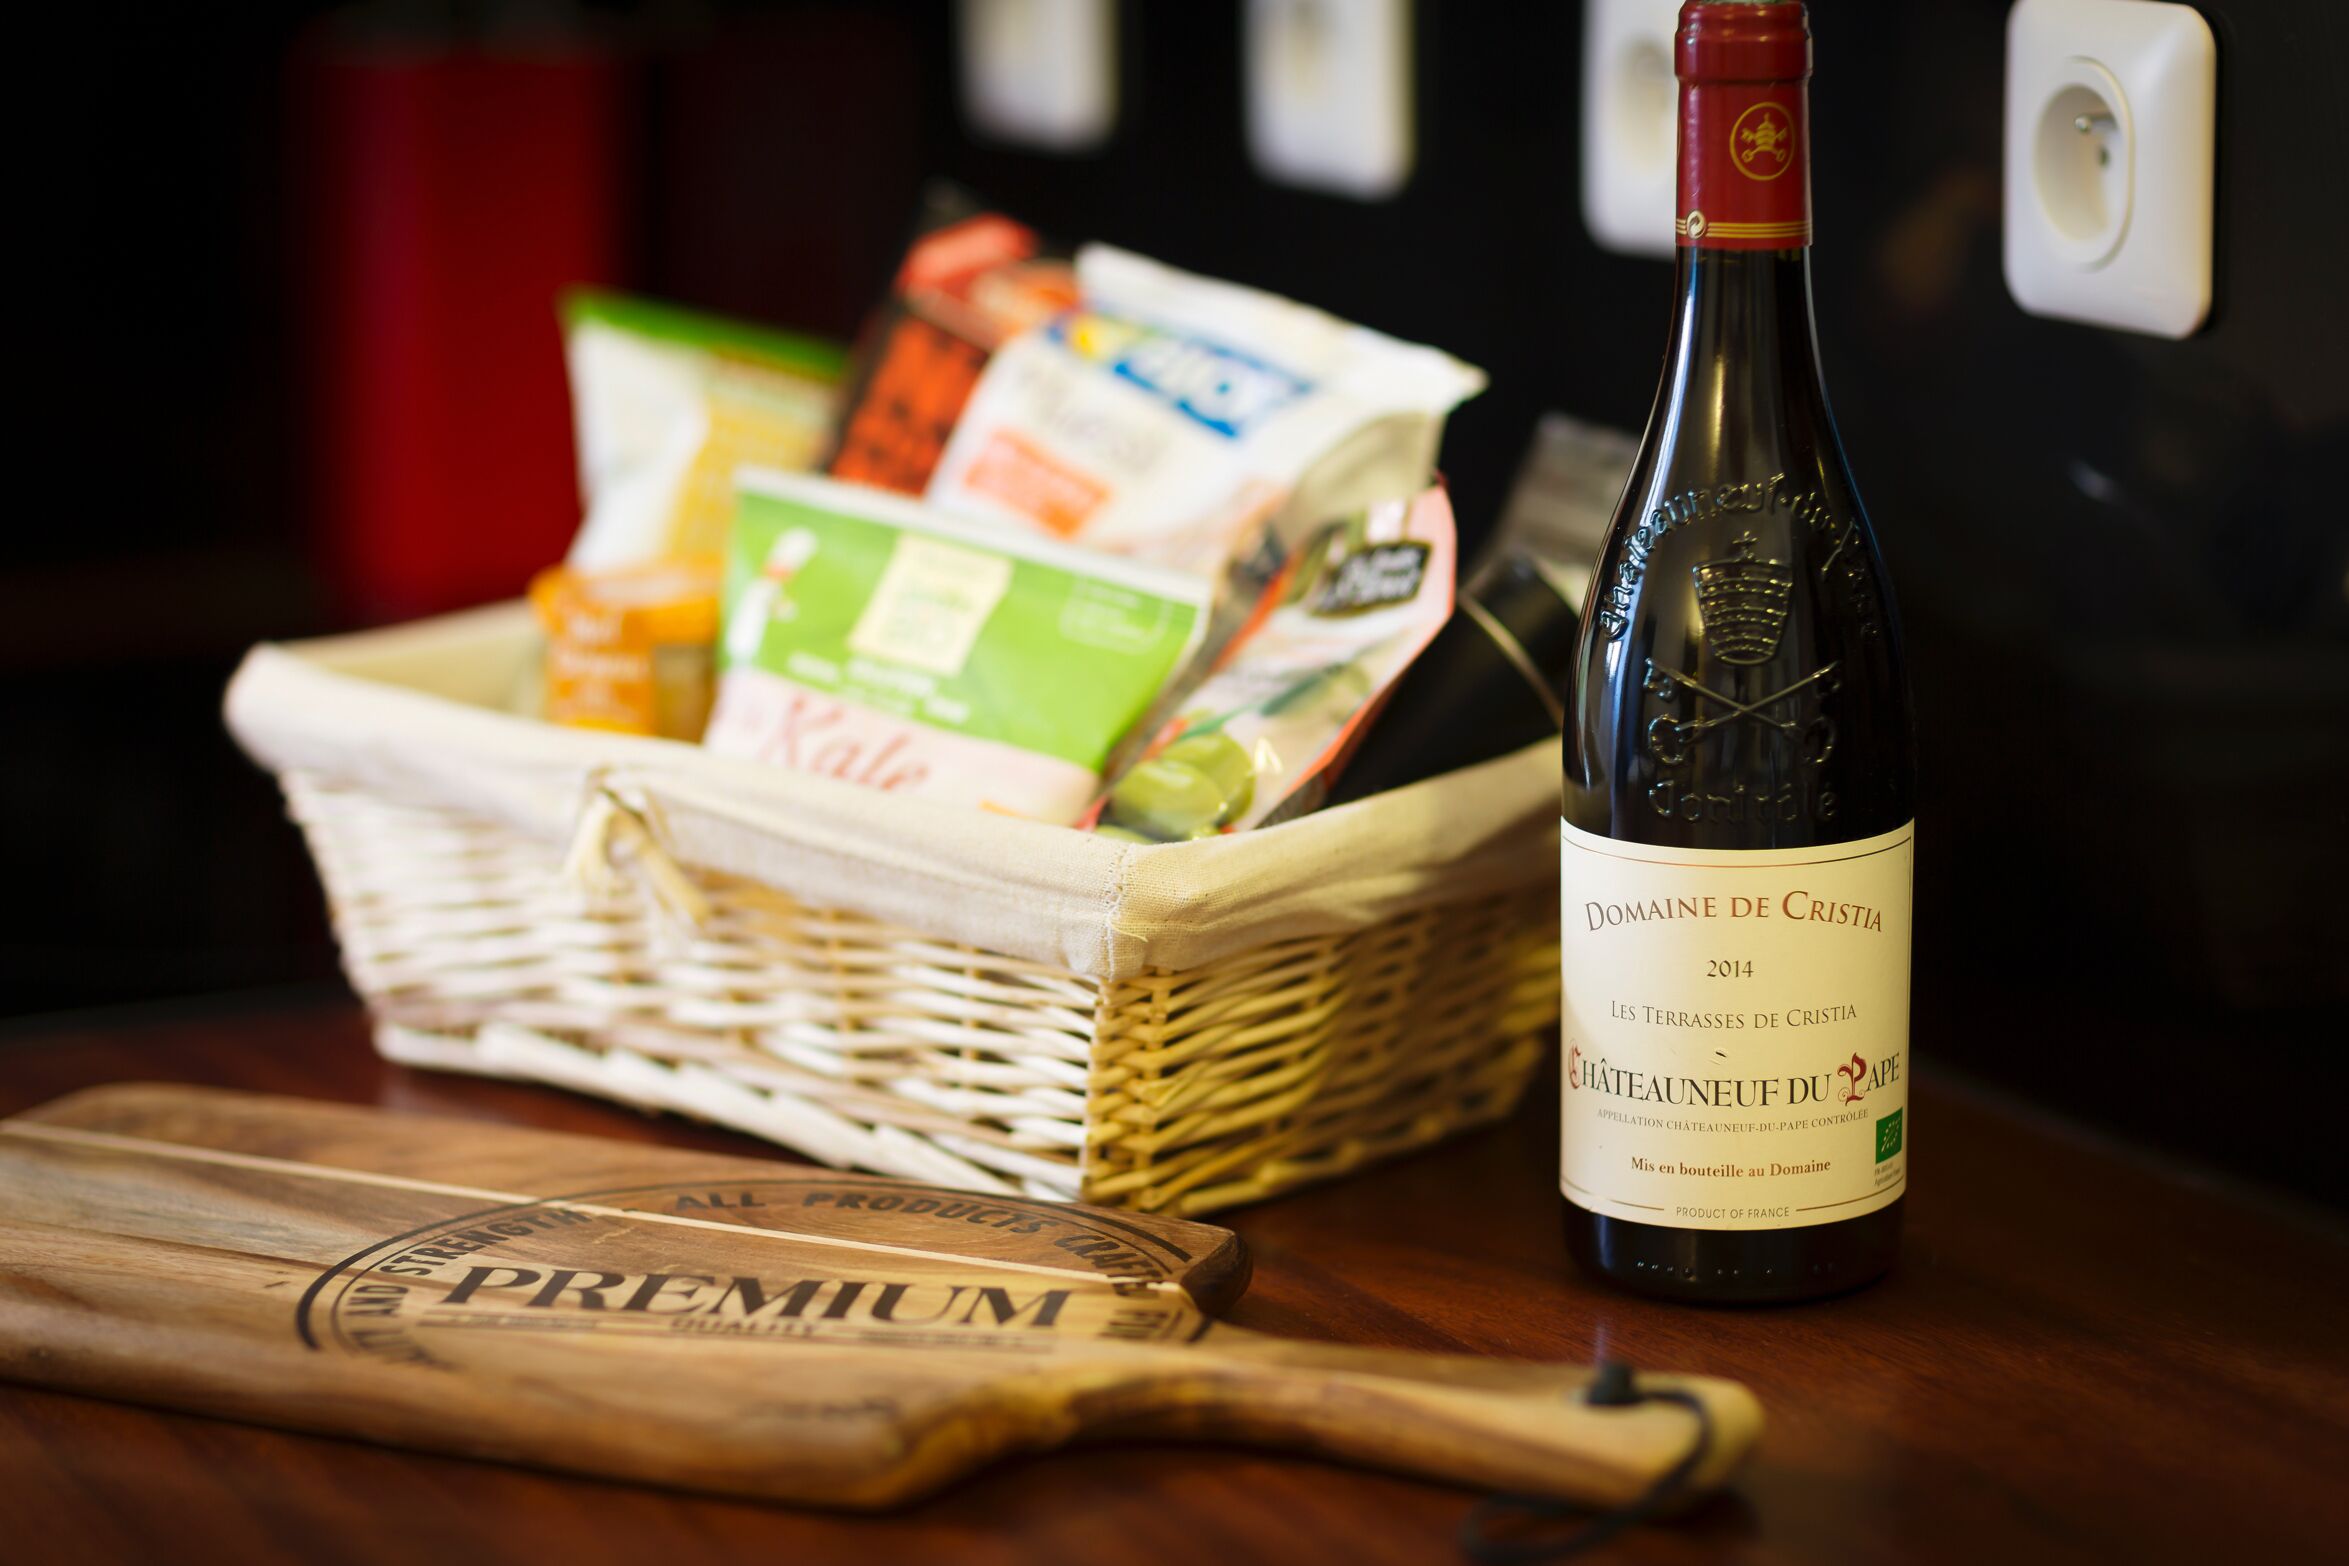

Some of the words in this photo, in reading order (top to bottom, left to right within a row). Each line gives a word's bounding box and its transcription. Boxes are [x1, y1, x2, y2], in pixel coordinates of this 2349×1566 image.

[1585, 896, 1717, 931] DOMAINE
[1729, 896, 1770, 918] DE
[1782, 890, 1882, 932] CRISTIA
[1706, 959, 1754, 978] 2014
[1611, 1000, 1636, 1021] LES
[1642, 1005, 1745, 1029] TERRASSES
[1754, 1013, 1779, 1029] DE
[1786, 1003, 1857, 1028] CRISTIA
[1568, 1039, 1779, 1108] CHÂTEAUNEUF
[1787, 1073, 1831, 1105] DU
[1837, 1052, 1900, 1107] PAPE
[1597, 1108, 1663, 1129] APPELLATION
[1631, 1156, 1655, 1173] Mis
[1659, 1163, 1675, 1175] en
[1679, 1161, 1744, 1178] bouteille
[1748, 1167, 1765, 1178] au
[1770, 1159, 1831, 1177] Domaine
[675, 1192, 766, 1211] ALL
[802, 1192, 1057, 1234] PRODUCTS
[1676, 1206, 1726, 1219] PRODUCT
[1729, 1208, 1744, 1219] OF
[1747, 1206, 1790, 1219] FRANCE
[380, 1208, 593, 1276] STRENGTH
[438, 1265, 1073, 1328] PREMIUM
